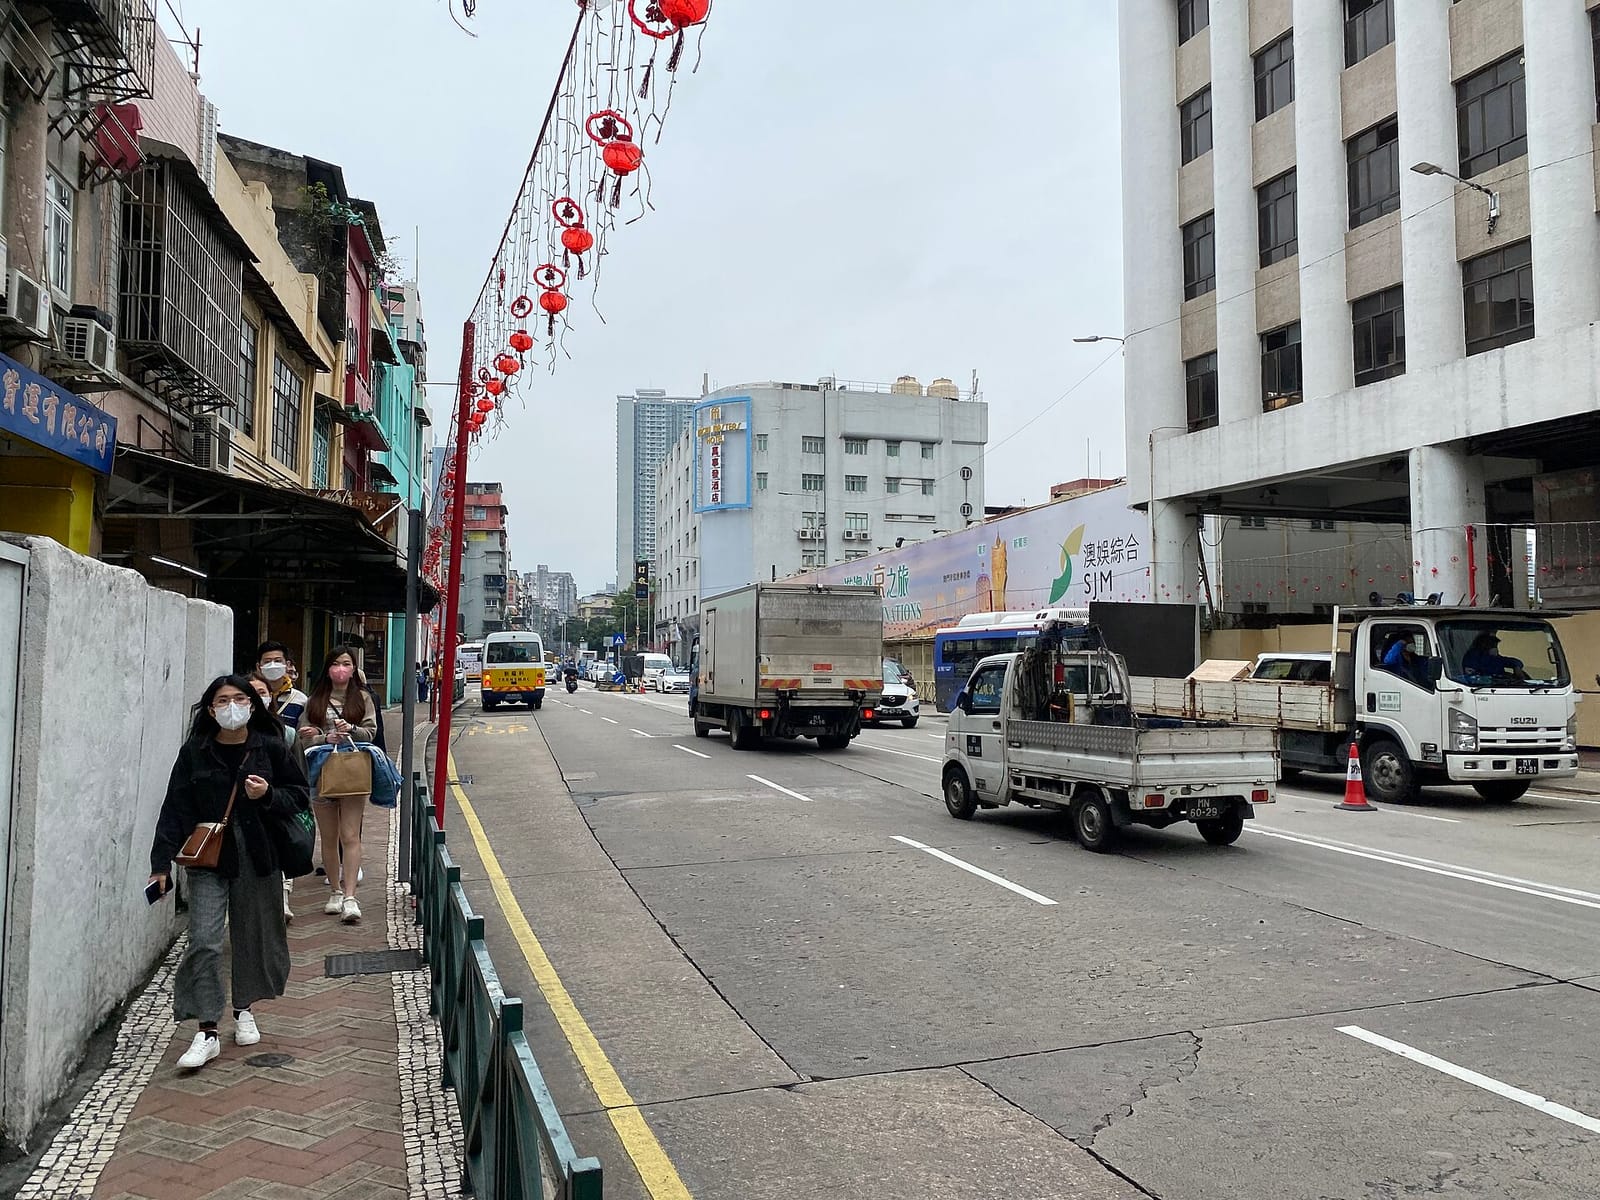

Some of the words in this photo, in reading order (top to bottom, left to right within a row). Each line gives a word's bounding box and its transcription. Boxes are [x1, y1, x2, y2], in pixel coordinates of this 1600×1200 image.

[1083, 533, 1139, 568] 澳娛綜合
[1084, 570, 1112, 600] SJM
[882, 602, 922, 622] NATIONS
[1510, 717, 1538, 725] ISUZU
[1518, 766, 1537, 774] 27-81
[1197, 799, 1210, 808] MN
[1190, 807, 1218, 818] 60-29
